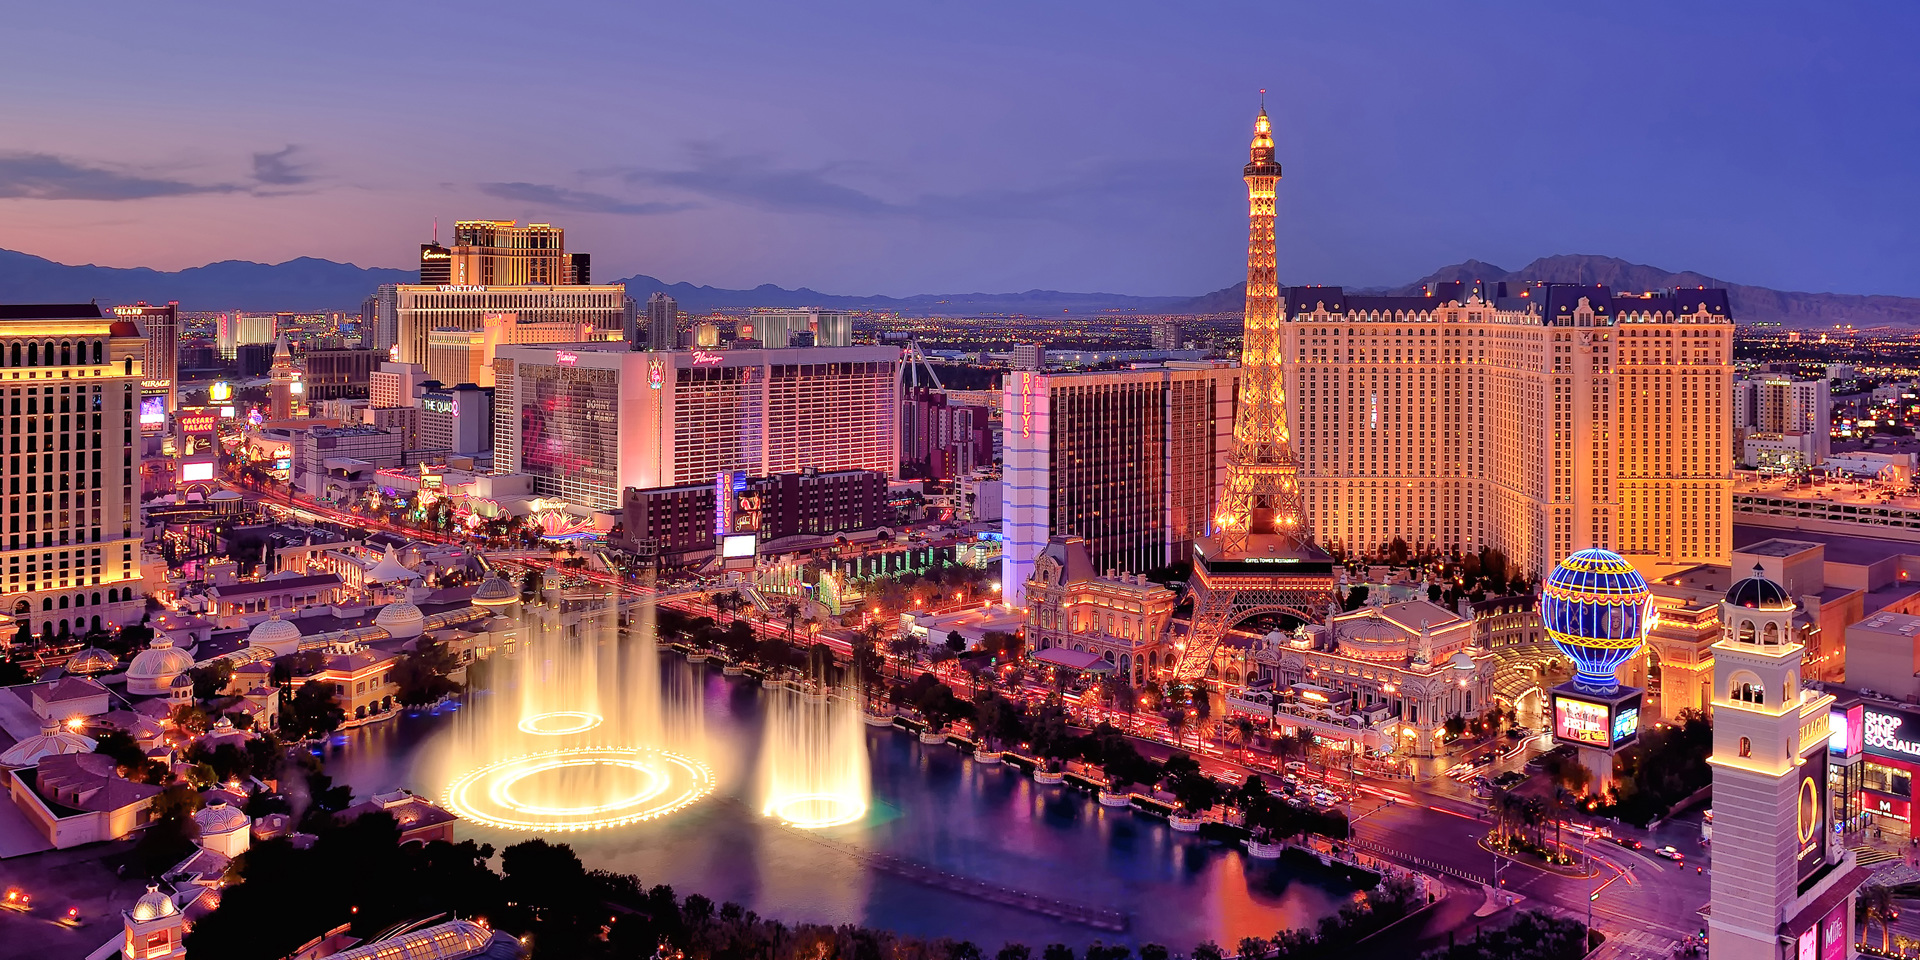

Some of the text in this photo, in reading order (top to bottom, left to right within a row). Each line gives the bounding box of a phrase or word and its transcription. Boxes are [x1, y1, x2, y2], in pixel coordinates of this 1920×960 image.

[423, 249, 451, 260] Encore
[692, 351, 724, 365] Flamingo
[140, 380, 171, 388] MIRAGE
[424, 400, 453, 414] THE QUAD
[182, 416, 215, 425] CAESARS
[183, 423, 213, 432] PALACE
[724, 474, 732, 528] BALLYS
[1864, 711, 1903, 730] SHOP
[1864, 721, 1897, 741] DINE
[1879, 800, 1891, 812] M
